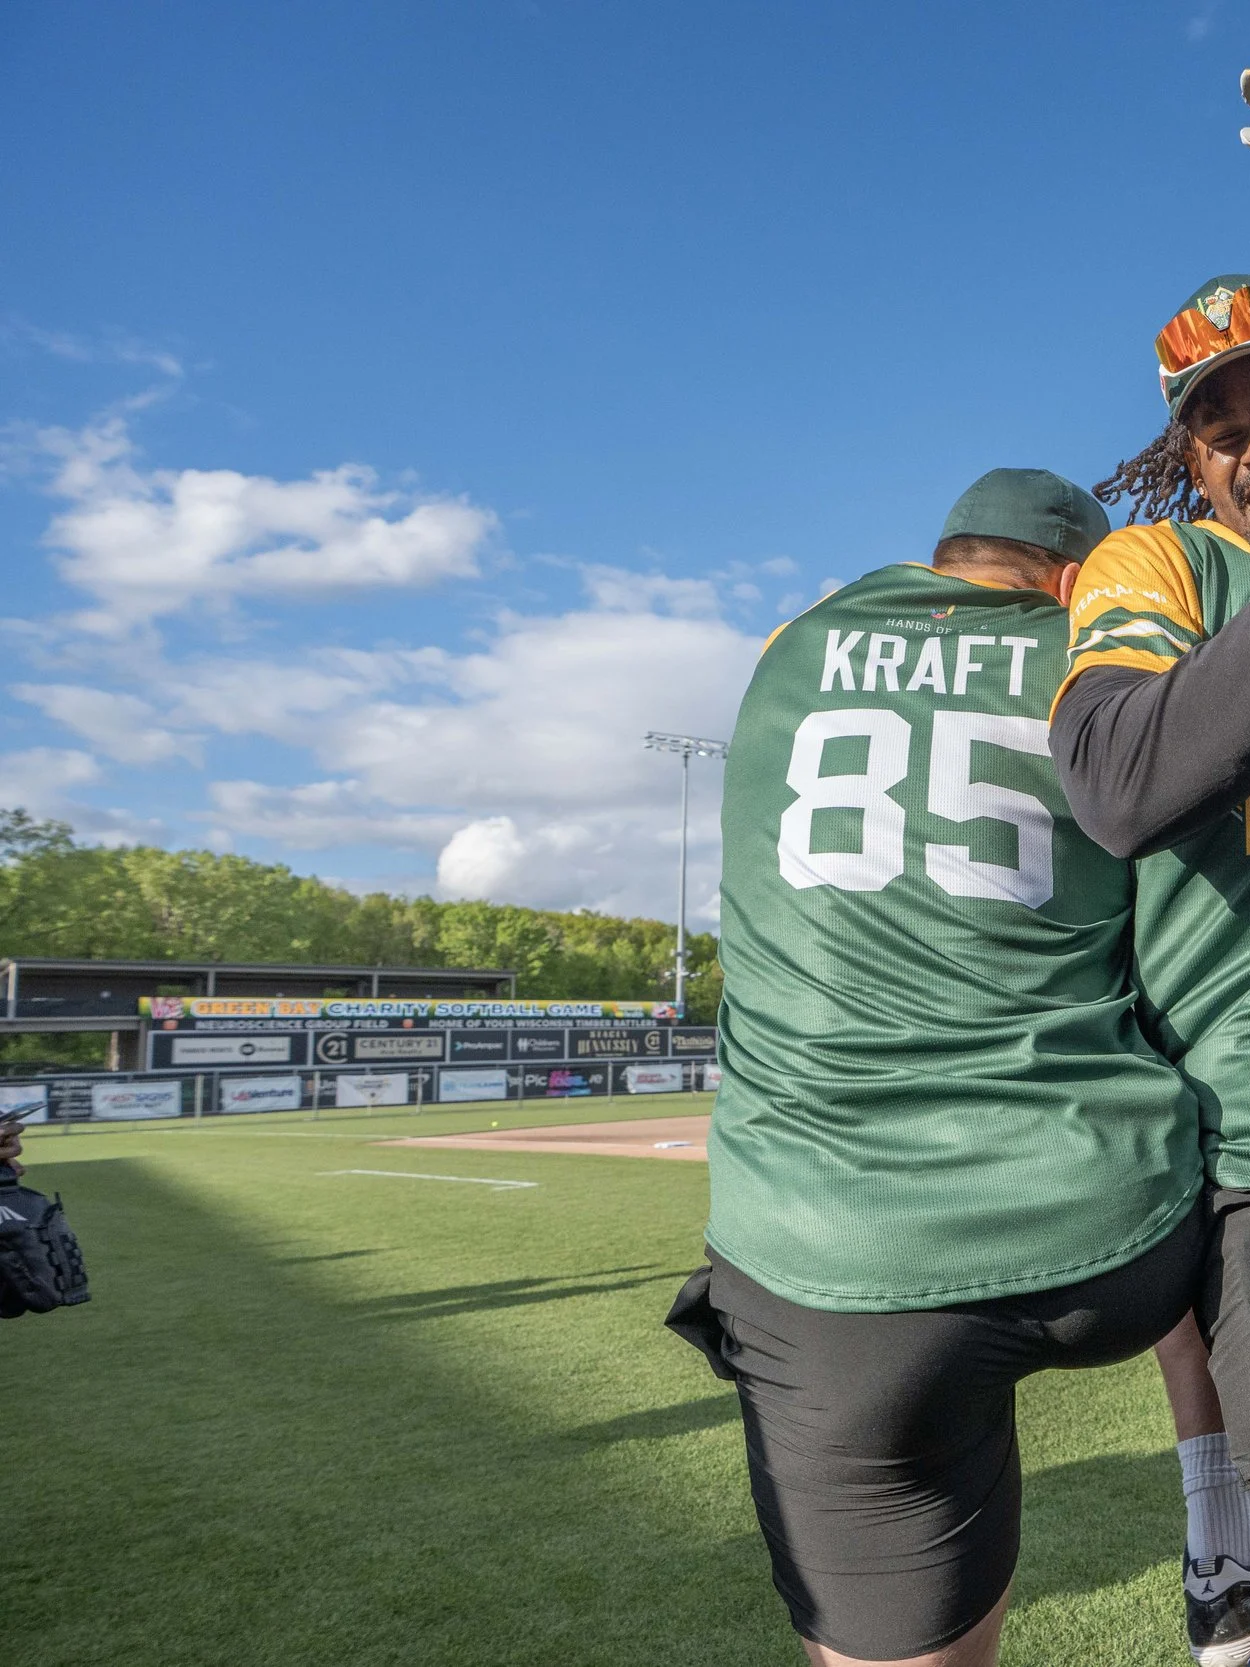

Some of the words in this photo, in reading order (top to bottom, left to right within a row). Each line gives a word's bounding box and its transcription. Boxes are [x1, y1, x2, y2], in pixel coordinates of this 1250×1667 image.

[885, 618, 931, 633] HANDS
[936, 626, 953, 635] OF
[820, 629, 1038, 697] KRAFT
[776, 708, 1055, 911] 85
[194, 1000, 271, 1015] GREEN
[276, 1000, 321, 1015] BAY
[328, 1002, 430, 1015] CHARITY
[436, 1003, 543, 1015] SOFTBALL
[548, 1003, 602, 1015] GAME
[195, 1020, 303, 1029] NEUROSCIENCE
[305, 1020, 351, 1028] GROUP
[353, 1020, 389, 1028] FIELD
[428, 1019, 463, 1028] HOME
[466, 1019, 482, 1028] OF
[484, 1019, 514, 1028] YOUR
[516, 1019, 573, 1027] WISCONSIN
[576, 1019, 611, 1027] TIMBER
[613, 1019, 657, 1027] RATTLERS
[589, 1030, 628, 1038] STACEY
[361, 1039, 421, 1049] CENTURY
[426, 1039, 438, 1048] 21
[577, 1039, 638, 1054] HENNESSEY
[525, 1074, 548, 1087] Pic
